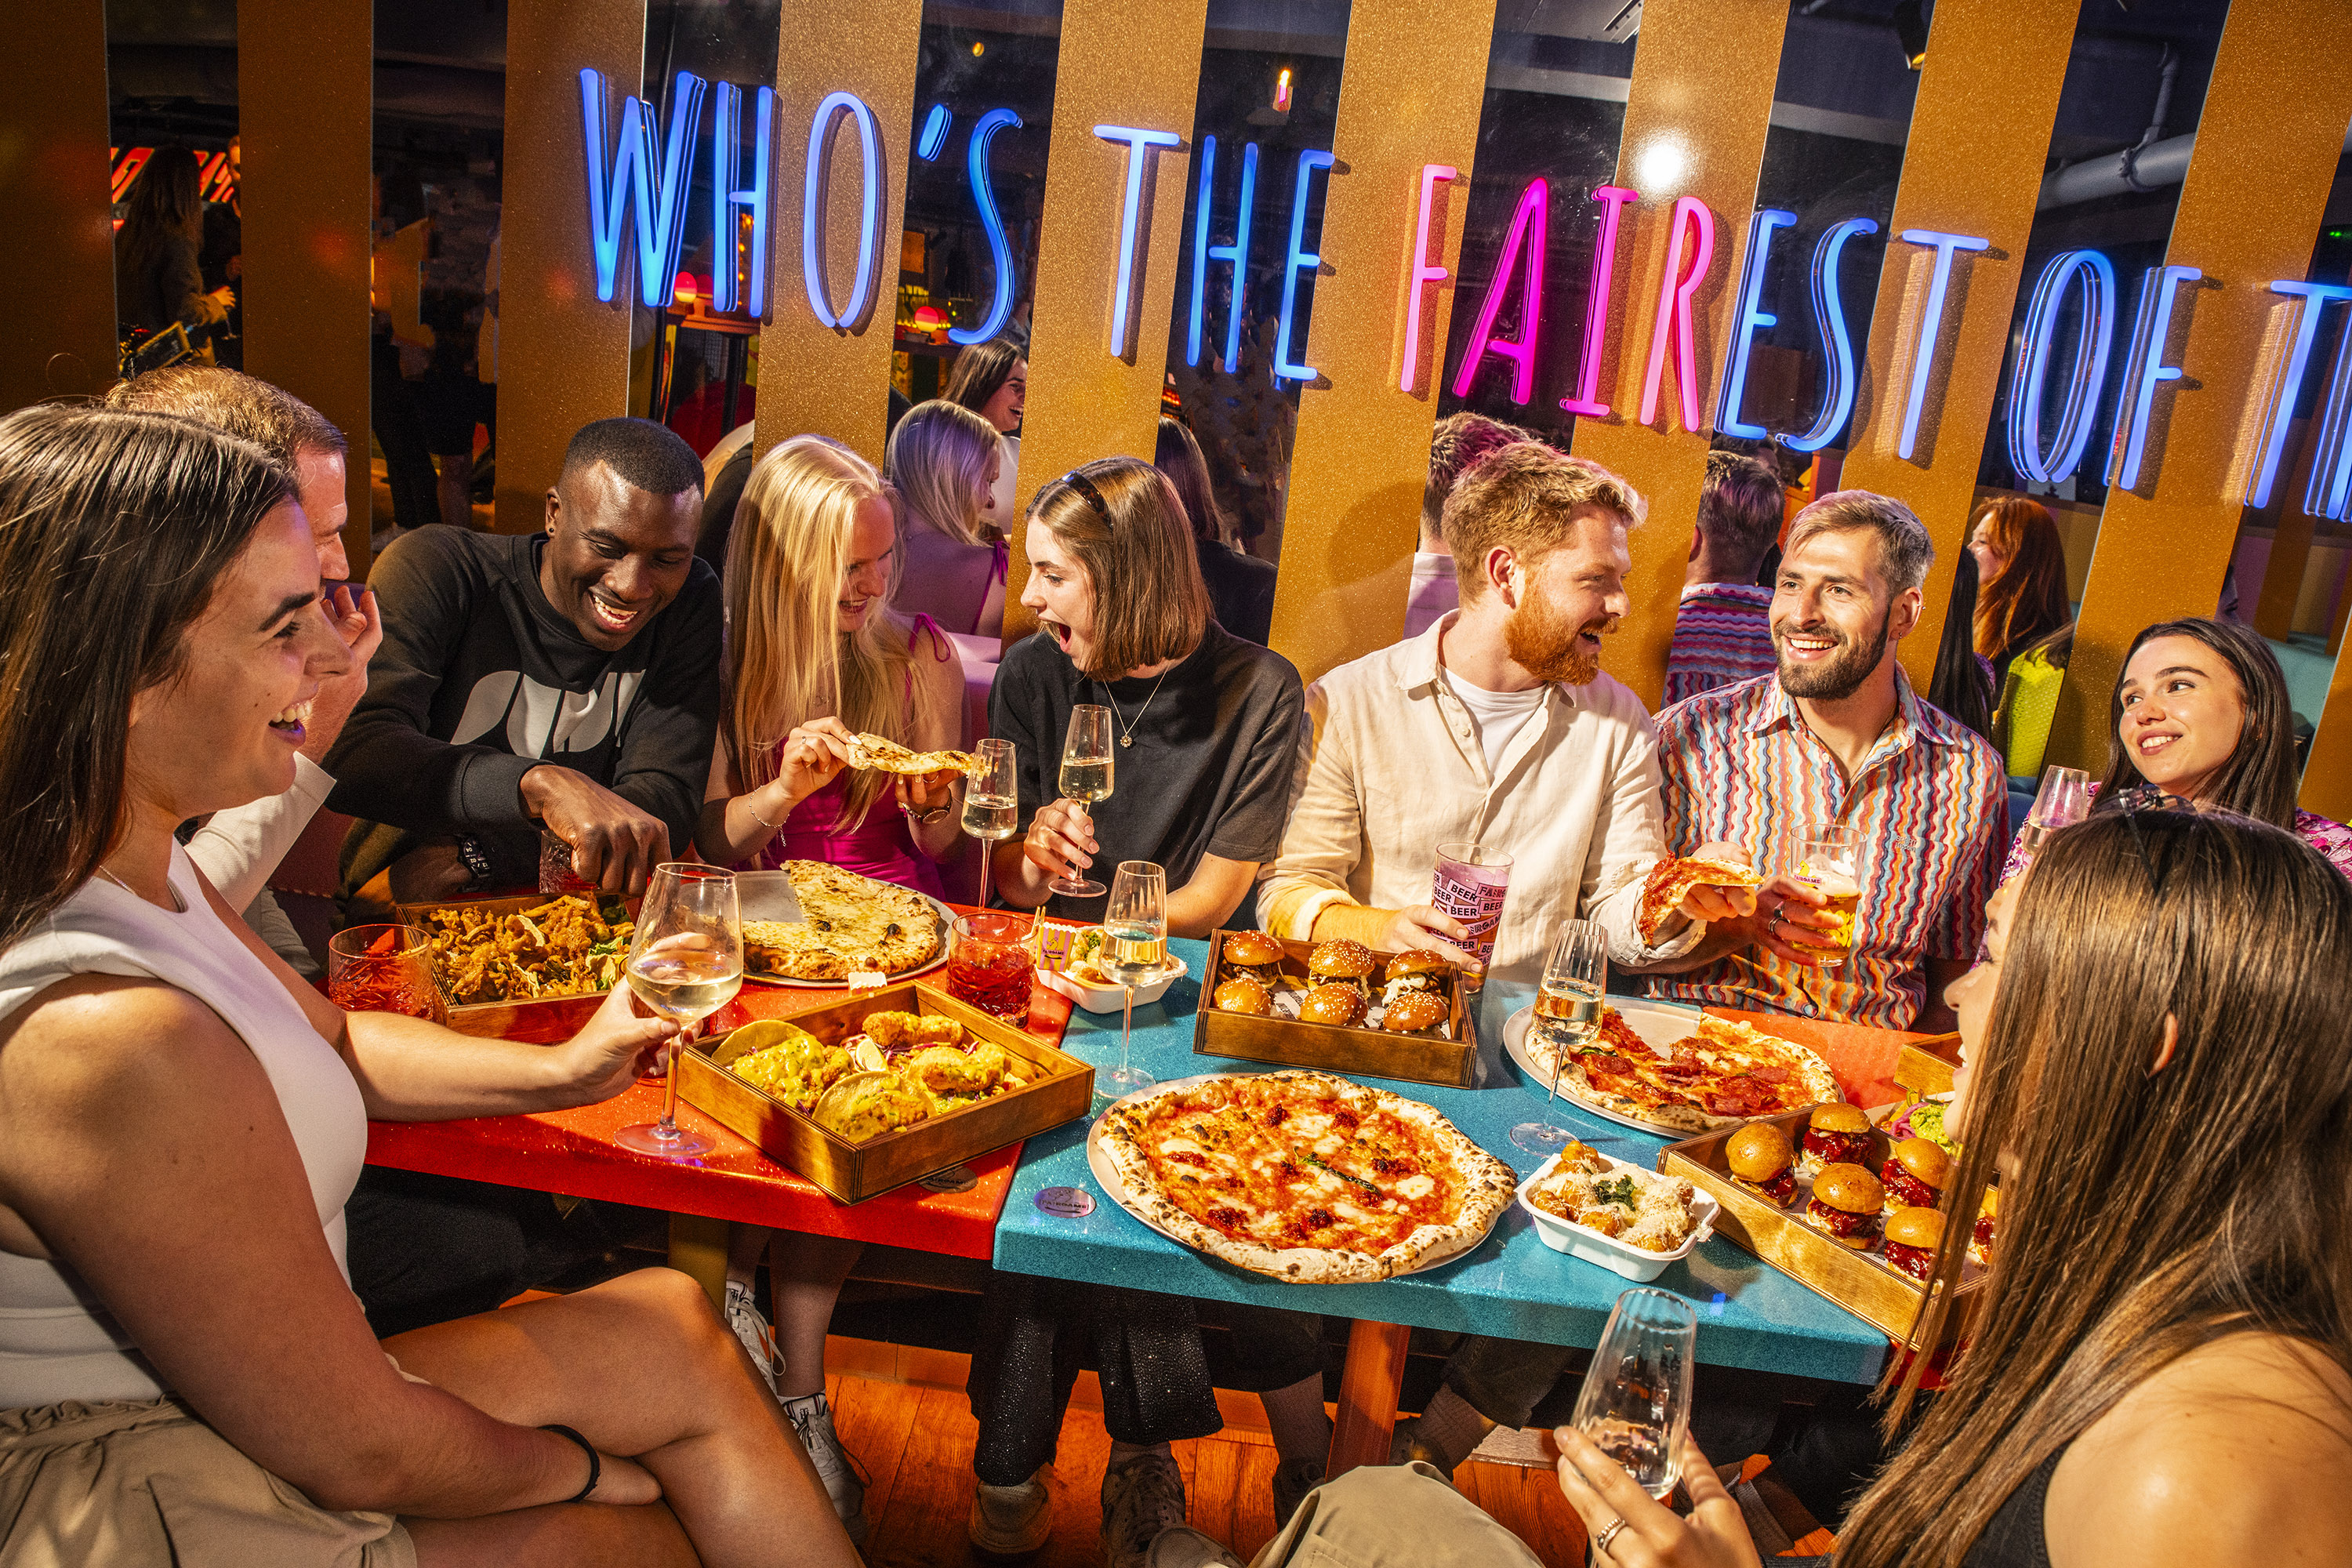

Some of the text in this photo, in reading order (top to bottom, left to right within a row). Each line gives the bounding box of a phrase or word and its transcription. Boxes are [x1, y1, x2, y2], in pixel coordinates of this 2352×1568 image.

[580, 68, 1022, 344] WHO'S
[1093, 125, 1334, 382] THE
[1400, 164, 1989, 460] FAIREST
[2008, 250, 2201, 491] OF
[1434, 886, 1451, 902] BEER
[1451, 884, 1477, 902] BEER
[1450, 906, 1477, 916] BEER
[1483, 901, 1503, 911] BEER
